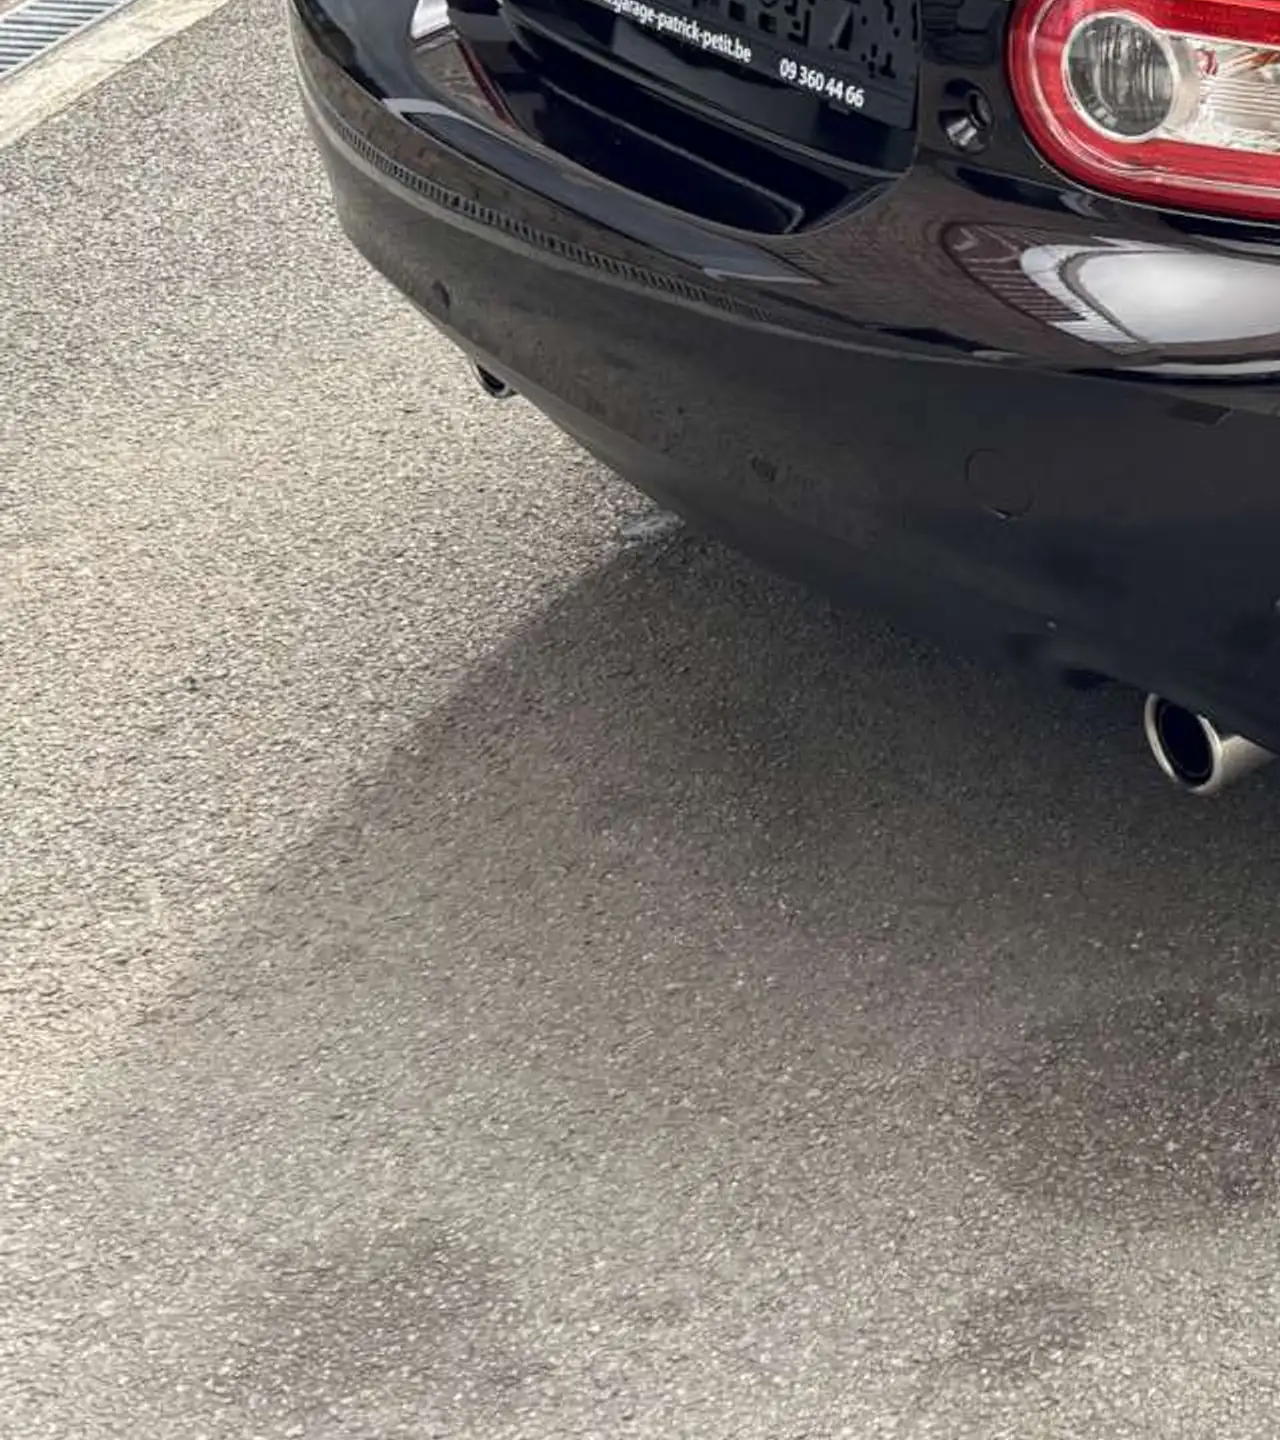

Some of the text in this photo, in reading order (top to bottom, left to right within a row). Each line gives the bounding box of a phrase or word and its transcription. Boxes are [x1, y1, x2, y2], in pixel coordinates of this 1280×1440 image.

[780, 58, 797, 80] 09
[798, 65, 825, 92] 360
[825, 77, 844, 100] 44
[846, 85, 865, 108] 66
